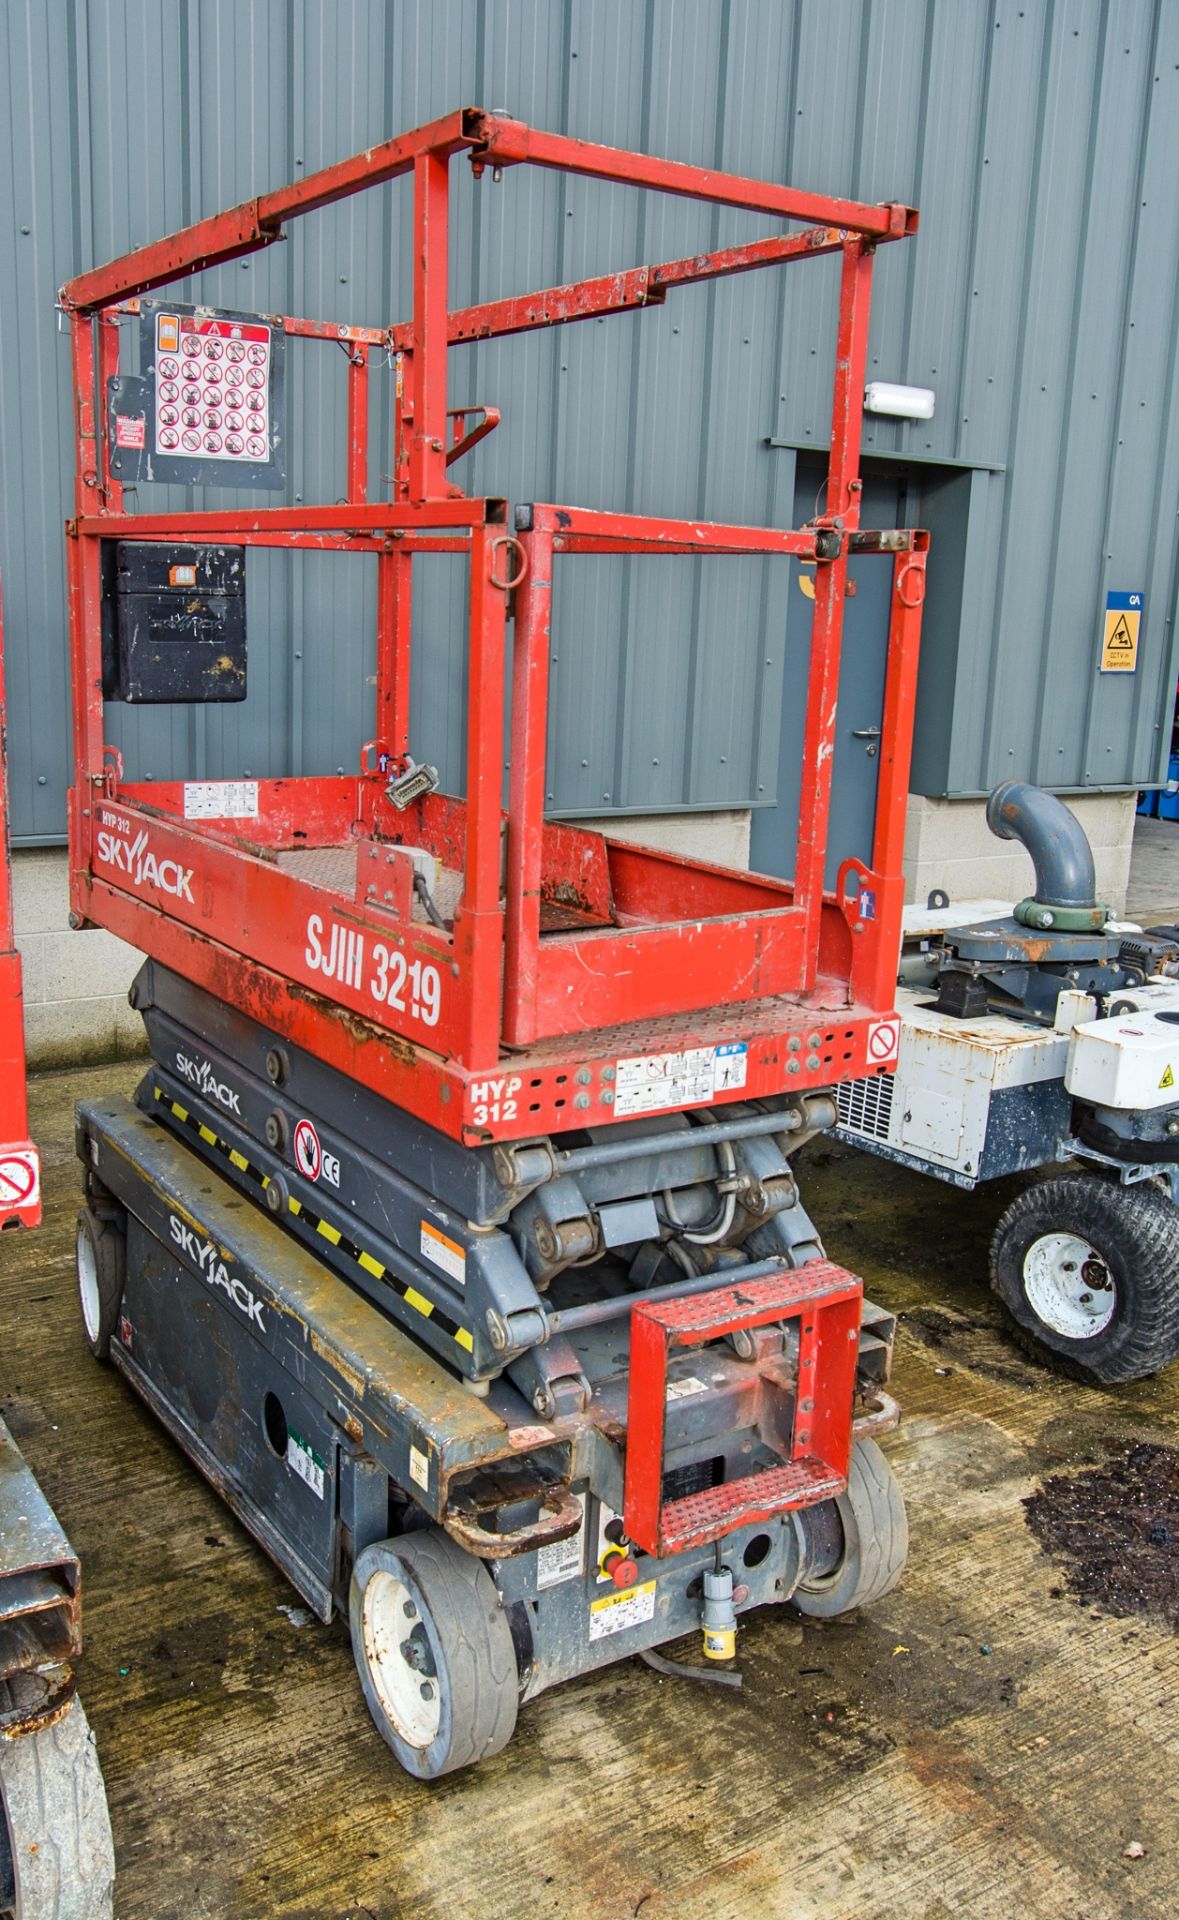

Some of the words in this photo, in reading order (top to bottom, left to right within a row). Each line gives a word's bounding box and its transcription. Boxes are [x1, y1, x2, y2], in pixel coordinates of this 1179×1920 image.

[1110, 651, 1123, 659] CCTV
[102, 810, 117, 828] HYP
[117, 817, 130, 835] 312
[97, 829, 195, 904] SKYJACK
[370, 943, 441, 1026] 3219
[176, 1052, 241, 1116] SKYJACK
[471, 1077, 522, 1103] HYP
[473, 1100, 517, 1125] 312
[170, 1215, 267, 1333] SKYJACK
